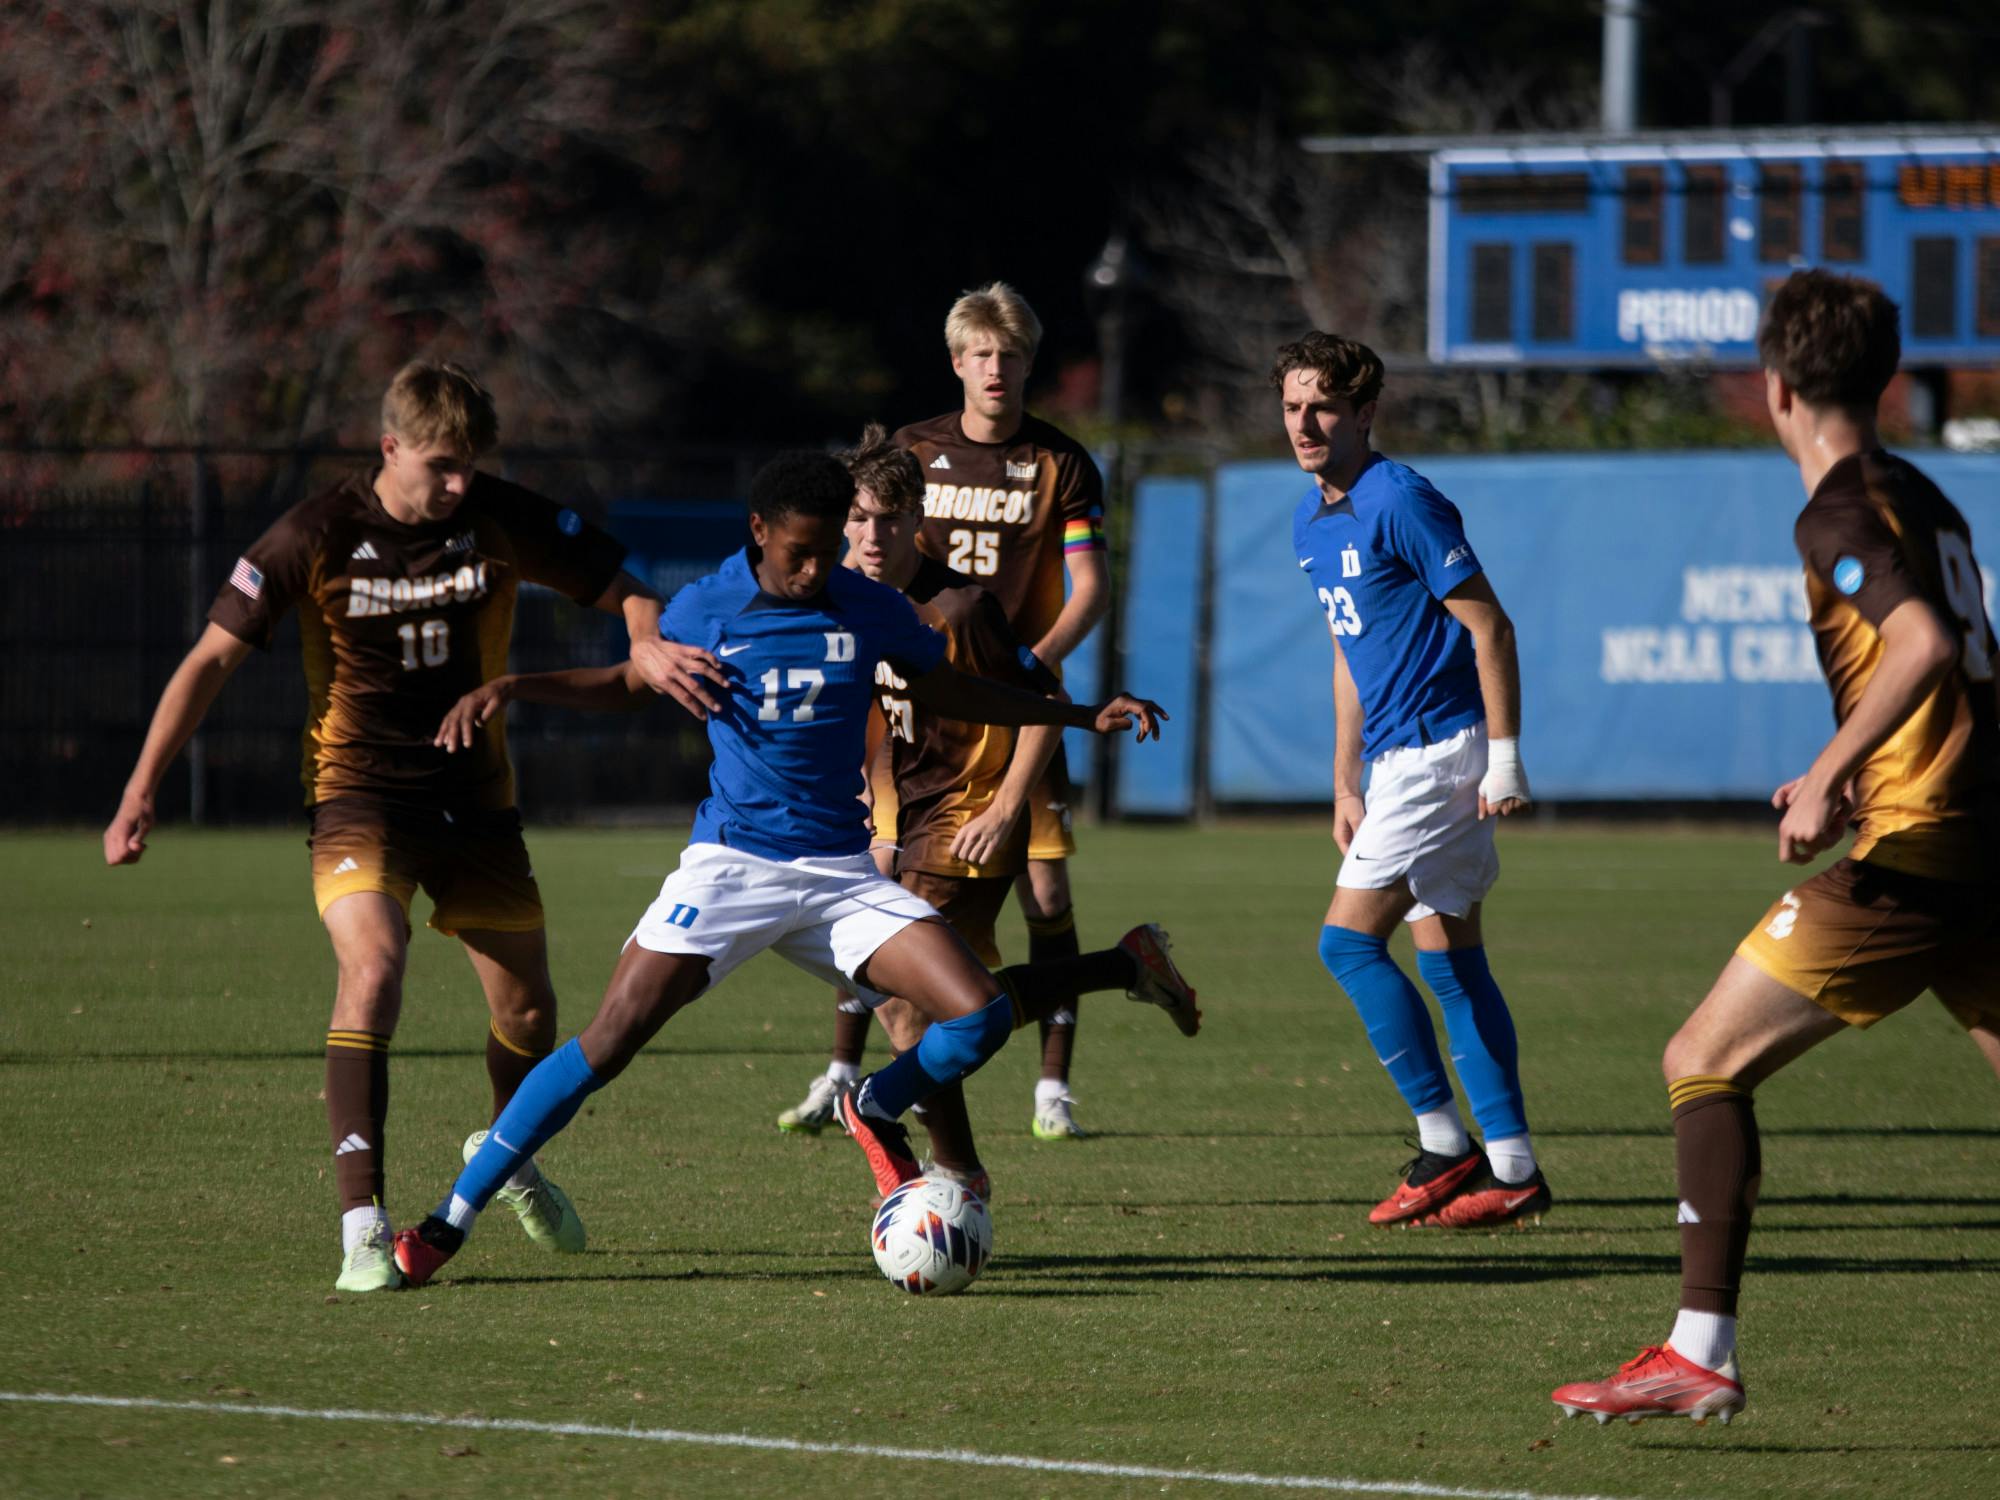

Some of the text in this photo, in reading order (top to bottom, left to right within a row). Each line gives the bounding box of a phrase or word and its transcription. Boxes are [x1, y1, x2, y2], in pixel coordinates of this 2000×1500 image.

[1618, 288, 1760, 342] PERIOD
[923, 482, 1038, 524] BRONCOS
[948, 529, 1000, 576] 25
[1318, 586, 1362, 635] 23
[398, 620, 449, 671] 10
[824, 632, 855, 662] D
[1602, 627, 1826, 683] NCAA CHA
[758, 668, 825, 722] 17
